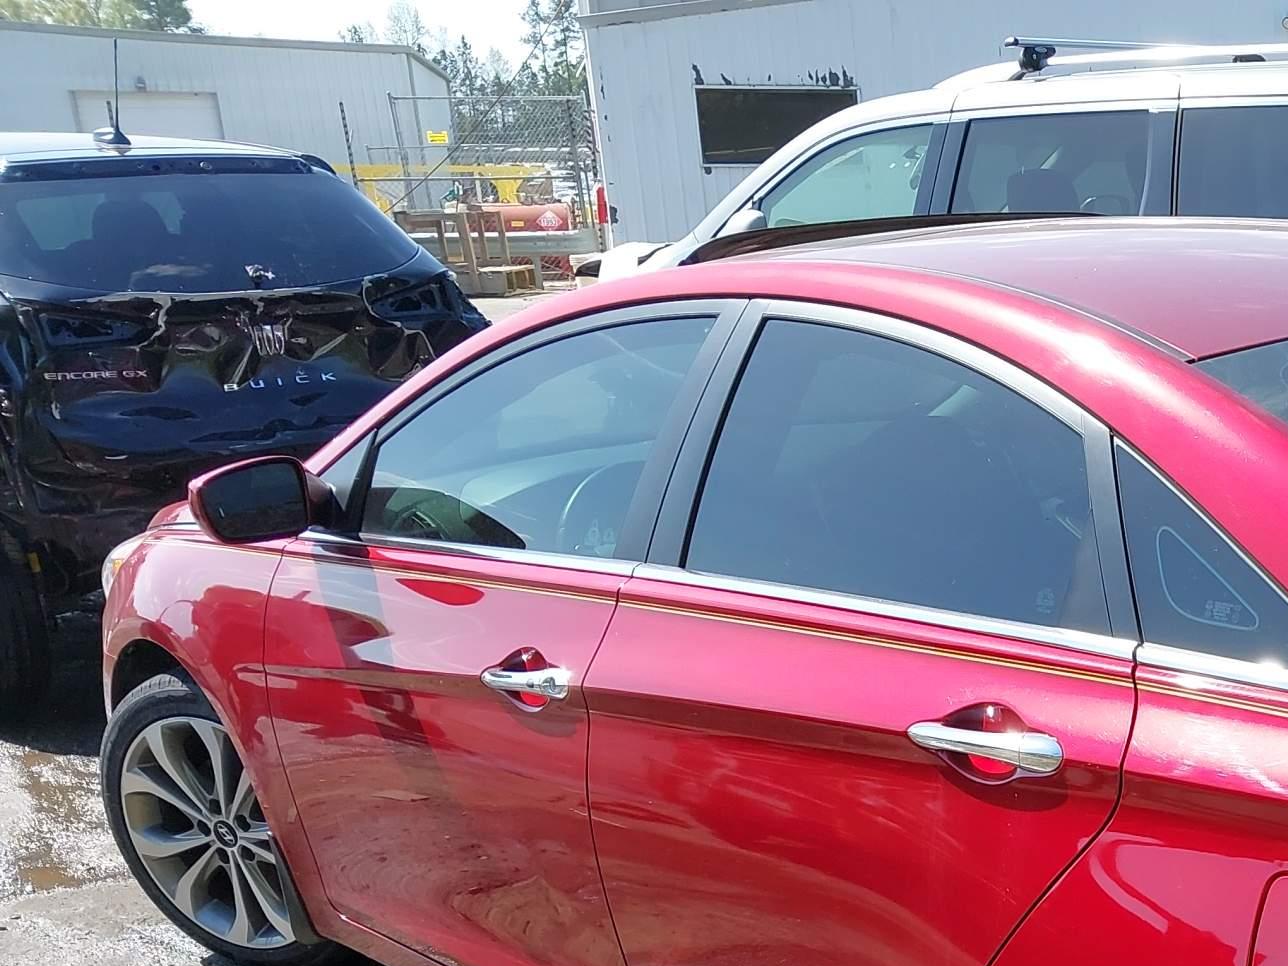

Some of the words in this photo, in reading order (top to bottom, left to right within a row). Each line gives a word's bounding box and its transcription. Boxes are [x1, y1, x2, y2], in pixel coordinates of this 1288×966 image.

[43, 371, 120, 381] ENCORE
[121, 369, 148, 379] GX
[223, 371, 338, 393] BUICK
